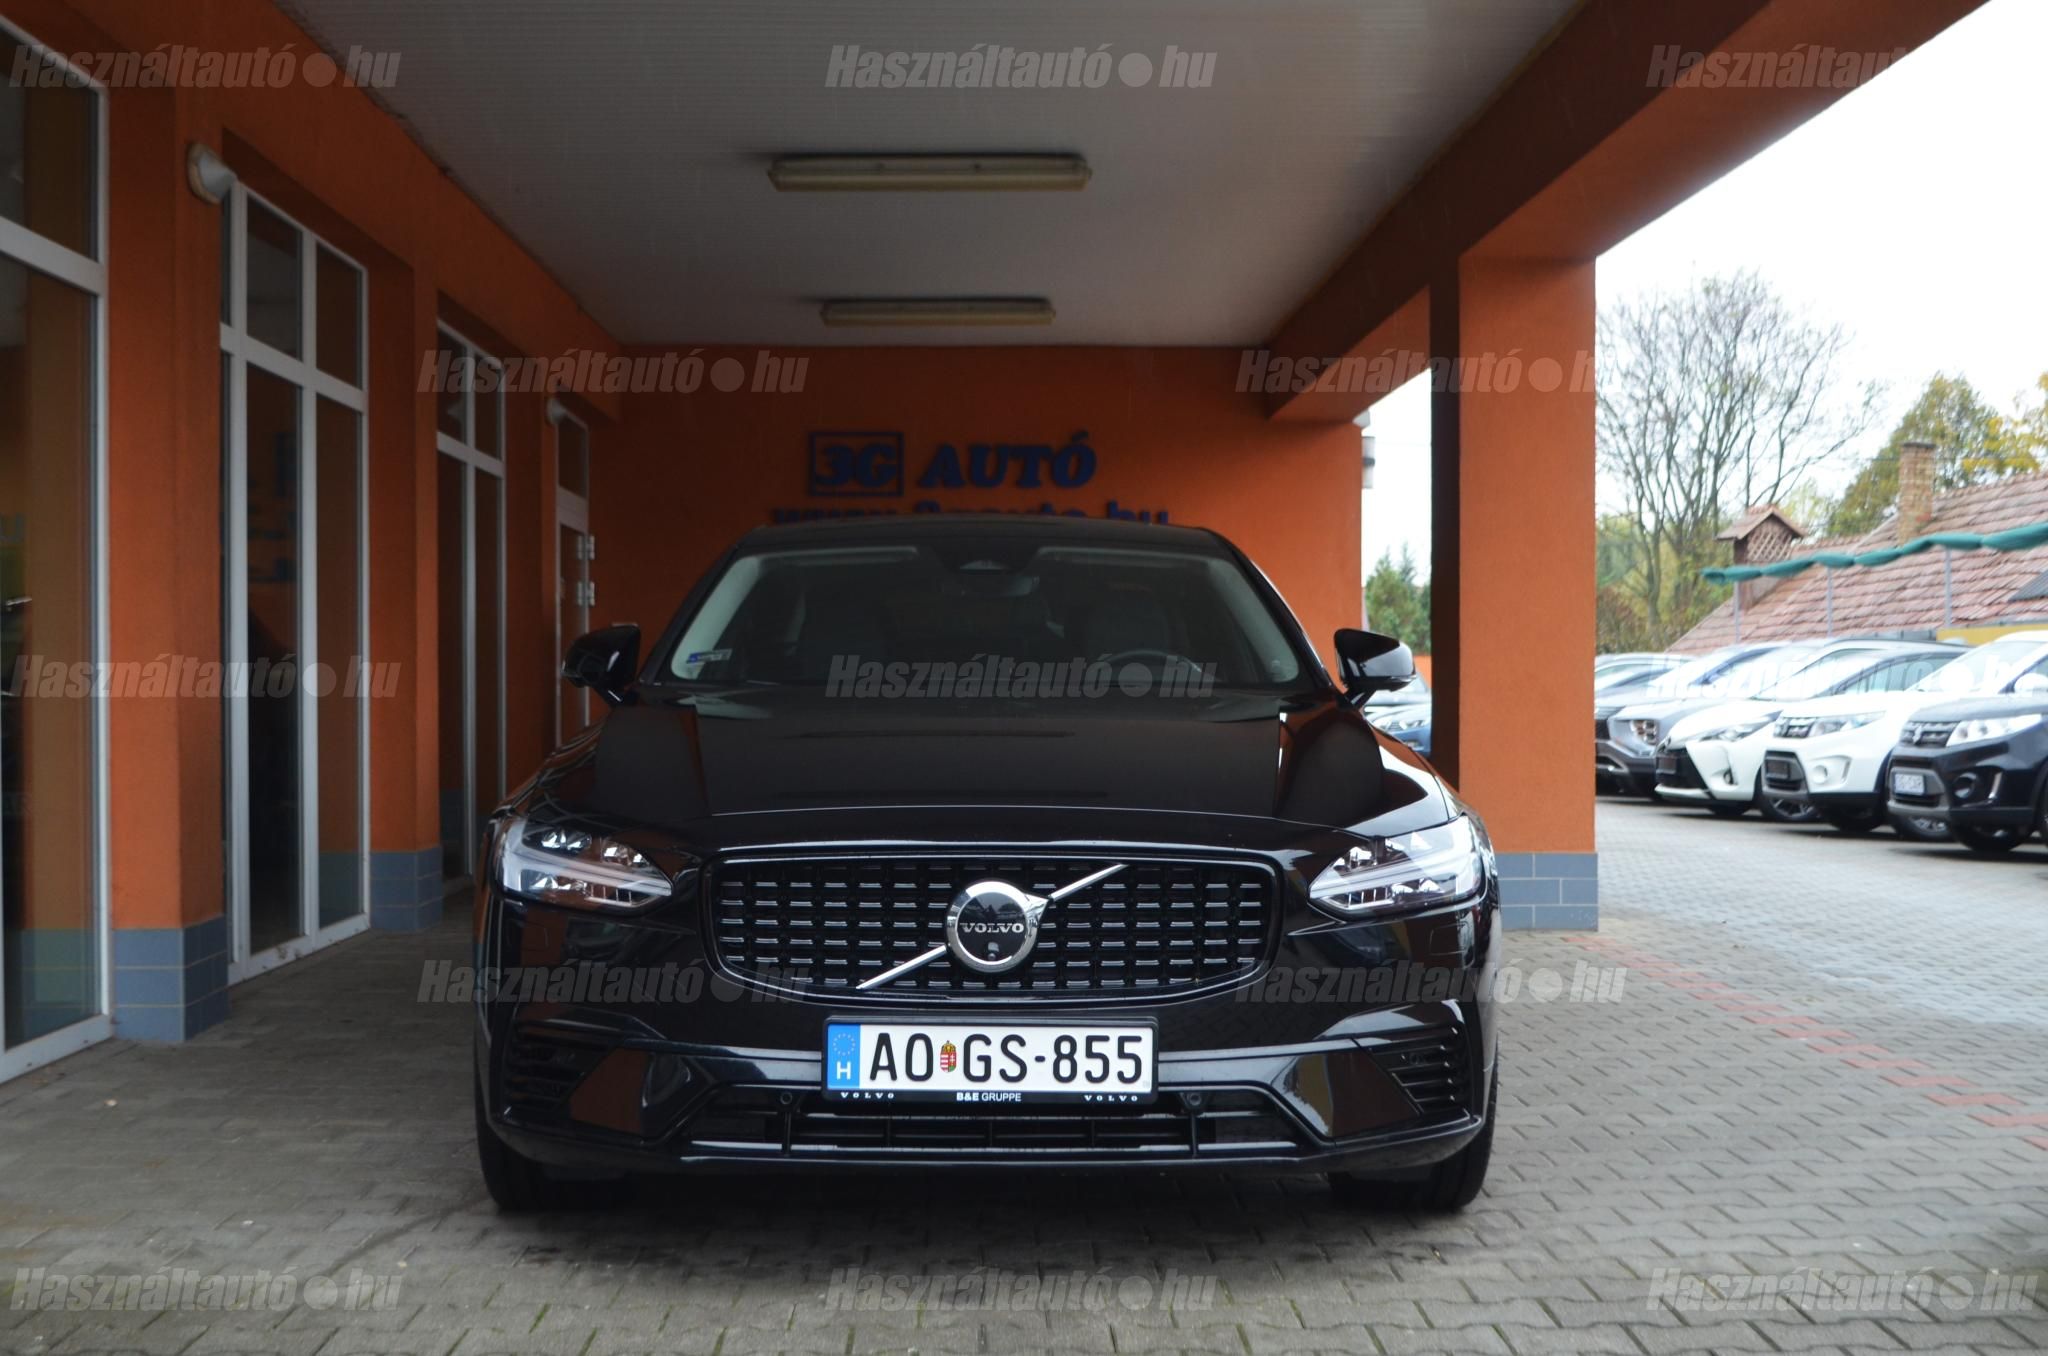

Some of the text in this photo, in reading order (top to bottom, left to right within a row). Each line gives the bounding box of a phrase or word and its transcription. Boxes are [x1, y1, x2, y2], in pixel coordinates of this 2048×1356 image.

[814, 430, 1098, 488] 3G AUTÓ
[960, 922, 1025, 934] VOLVO
[963, 1033, 1143, 1084] GS-855
[836, 1061, 852, 1081] H
[840, 1091, 895, 1099] VOLVO
[956, 1091, 1022, 1103] B&E GRUPPE
[1084, 1094, 1138, 1102] VOLVO
